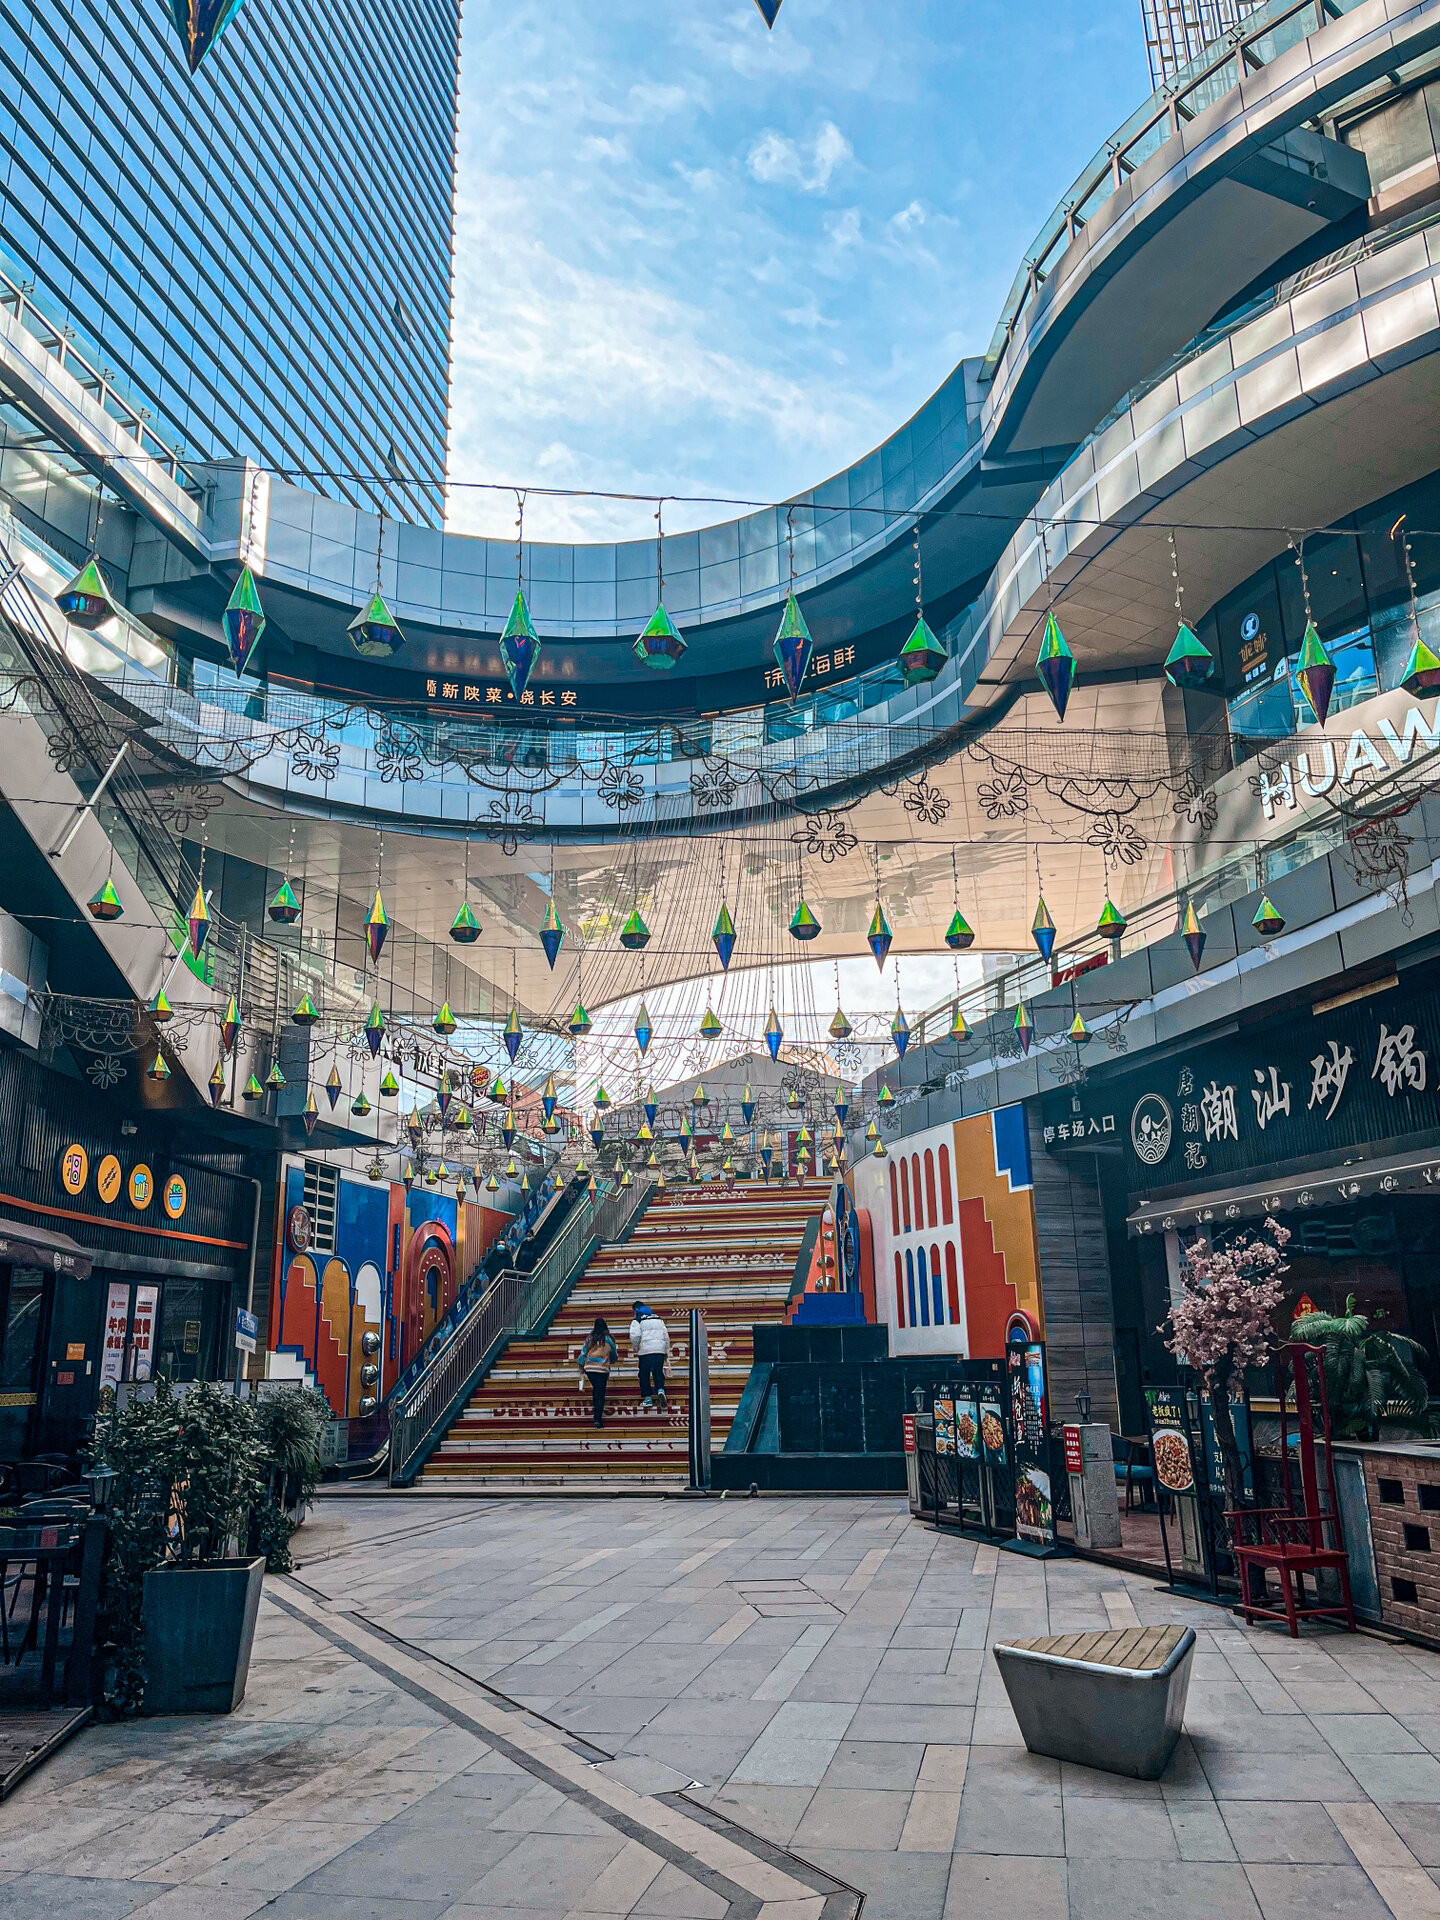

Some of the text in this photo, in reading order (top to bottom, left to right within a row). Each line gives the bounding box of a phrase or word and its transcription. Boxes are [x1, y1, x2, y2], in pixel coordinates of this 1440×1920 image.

[764, 645, 856, 689] 徐海鲜
[1200, 1023, 1427, 1142] 潮汕砂锅
[1043, 1114, 1116, 1144] 停车场入口
[1177, 1066, 1205, 1170] 唐潮记
[614, 1253, 786, 1270] TREND OF THE BLOCK
